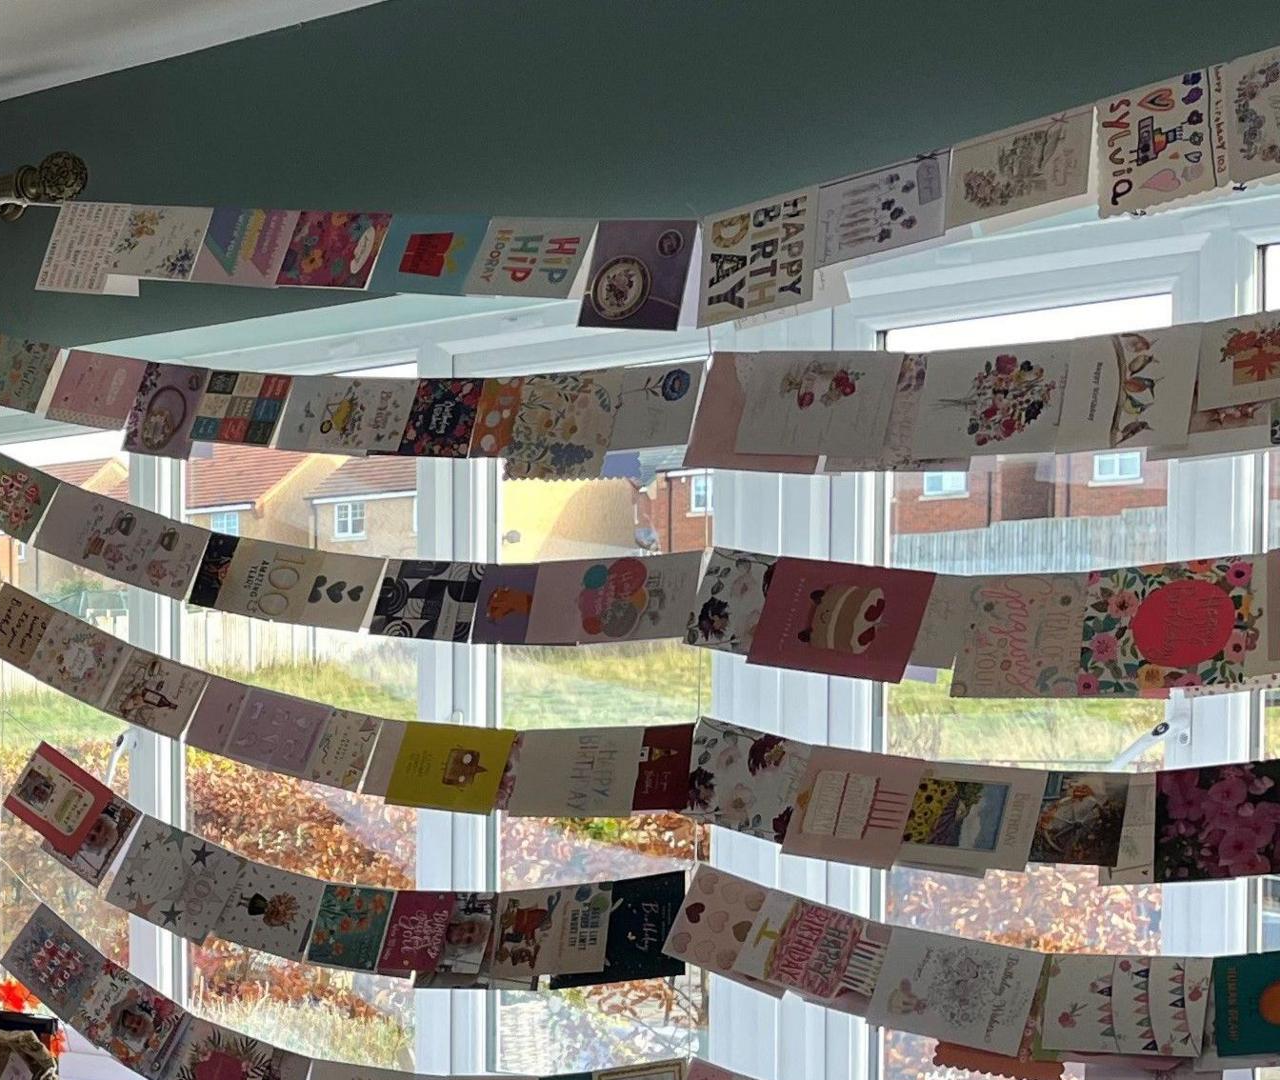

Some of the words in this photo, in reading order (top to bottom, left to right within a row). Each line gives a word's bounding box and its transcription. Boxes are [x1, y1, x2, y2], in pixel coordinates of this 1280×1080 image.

[708, 212, 751, 309] DAY
[746, 203, 782, 308] BIRTH
[778, 194, 808, 297] HAPPY
[243, 564, 260, 590] YEARS
[249, 559, 271, 598] AMAZING
[259, 552, 309, 618] 100
[1045, 611, 1072, 643] YEAR
[635, 902, 660, 951] Birthday
[776, 904, 830, 983] BIRTHDAY
